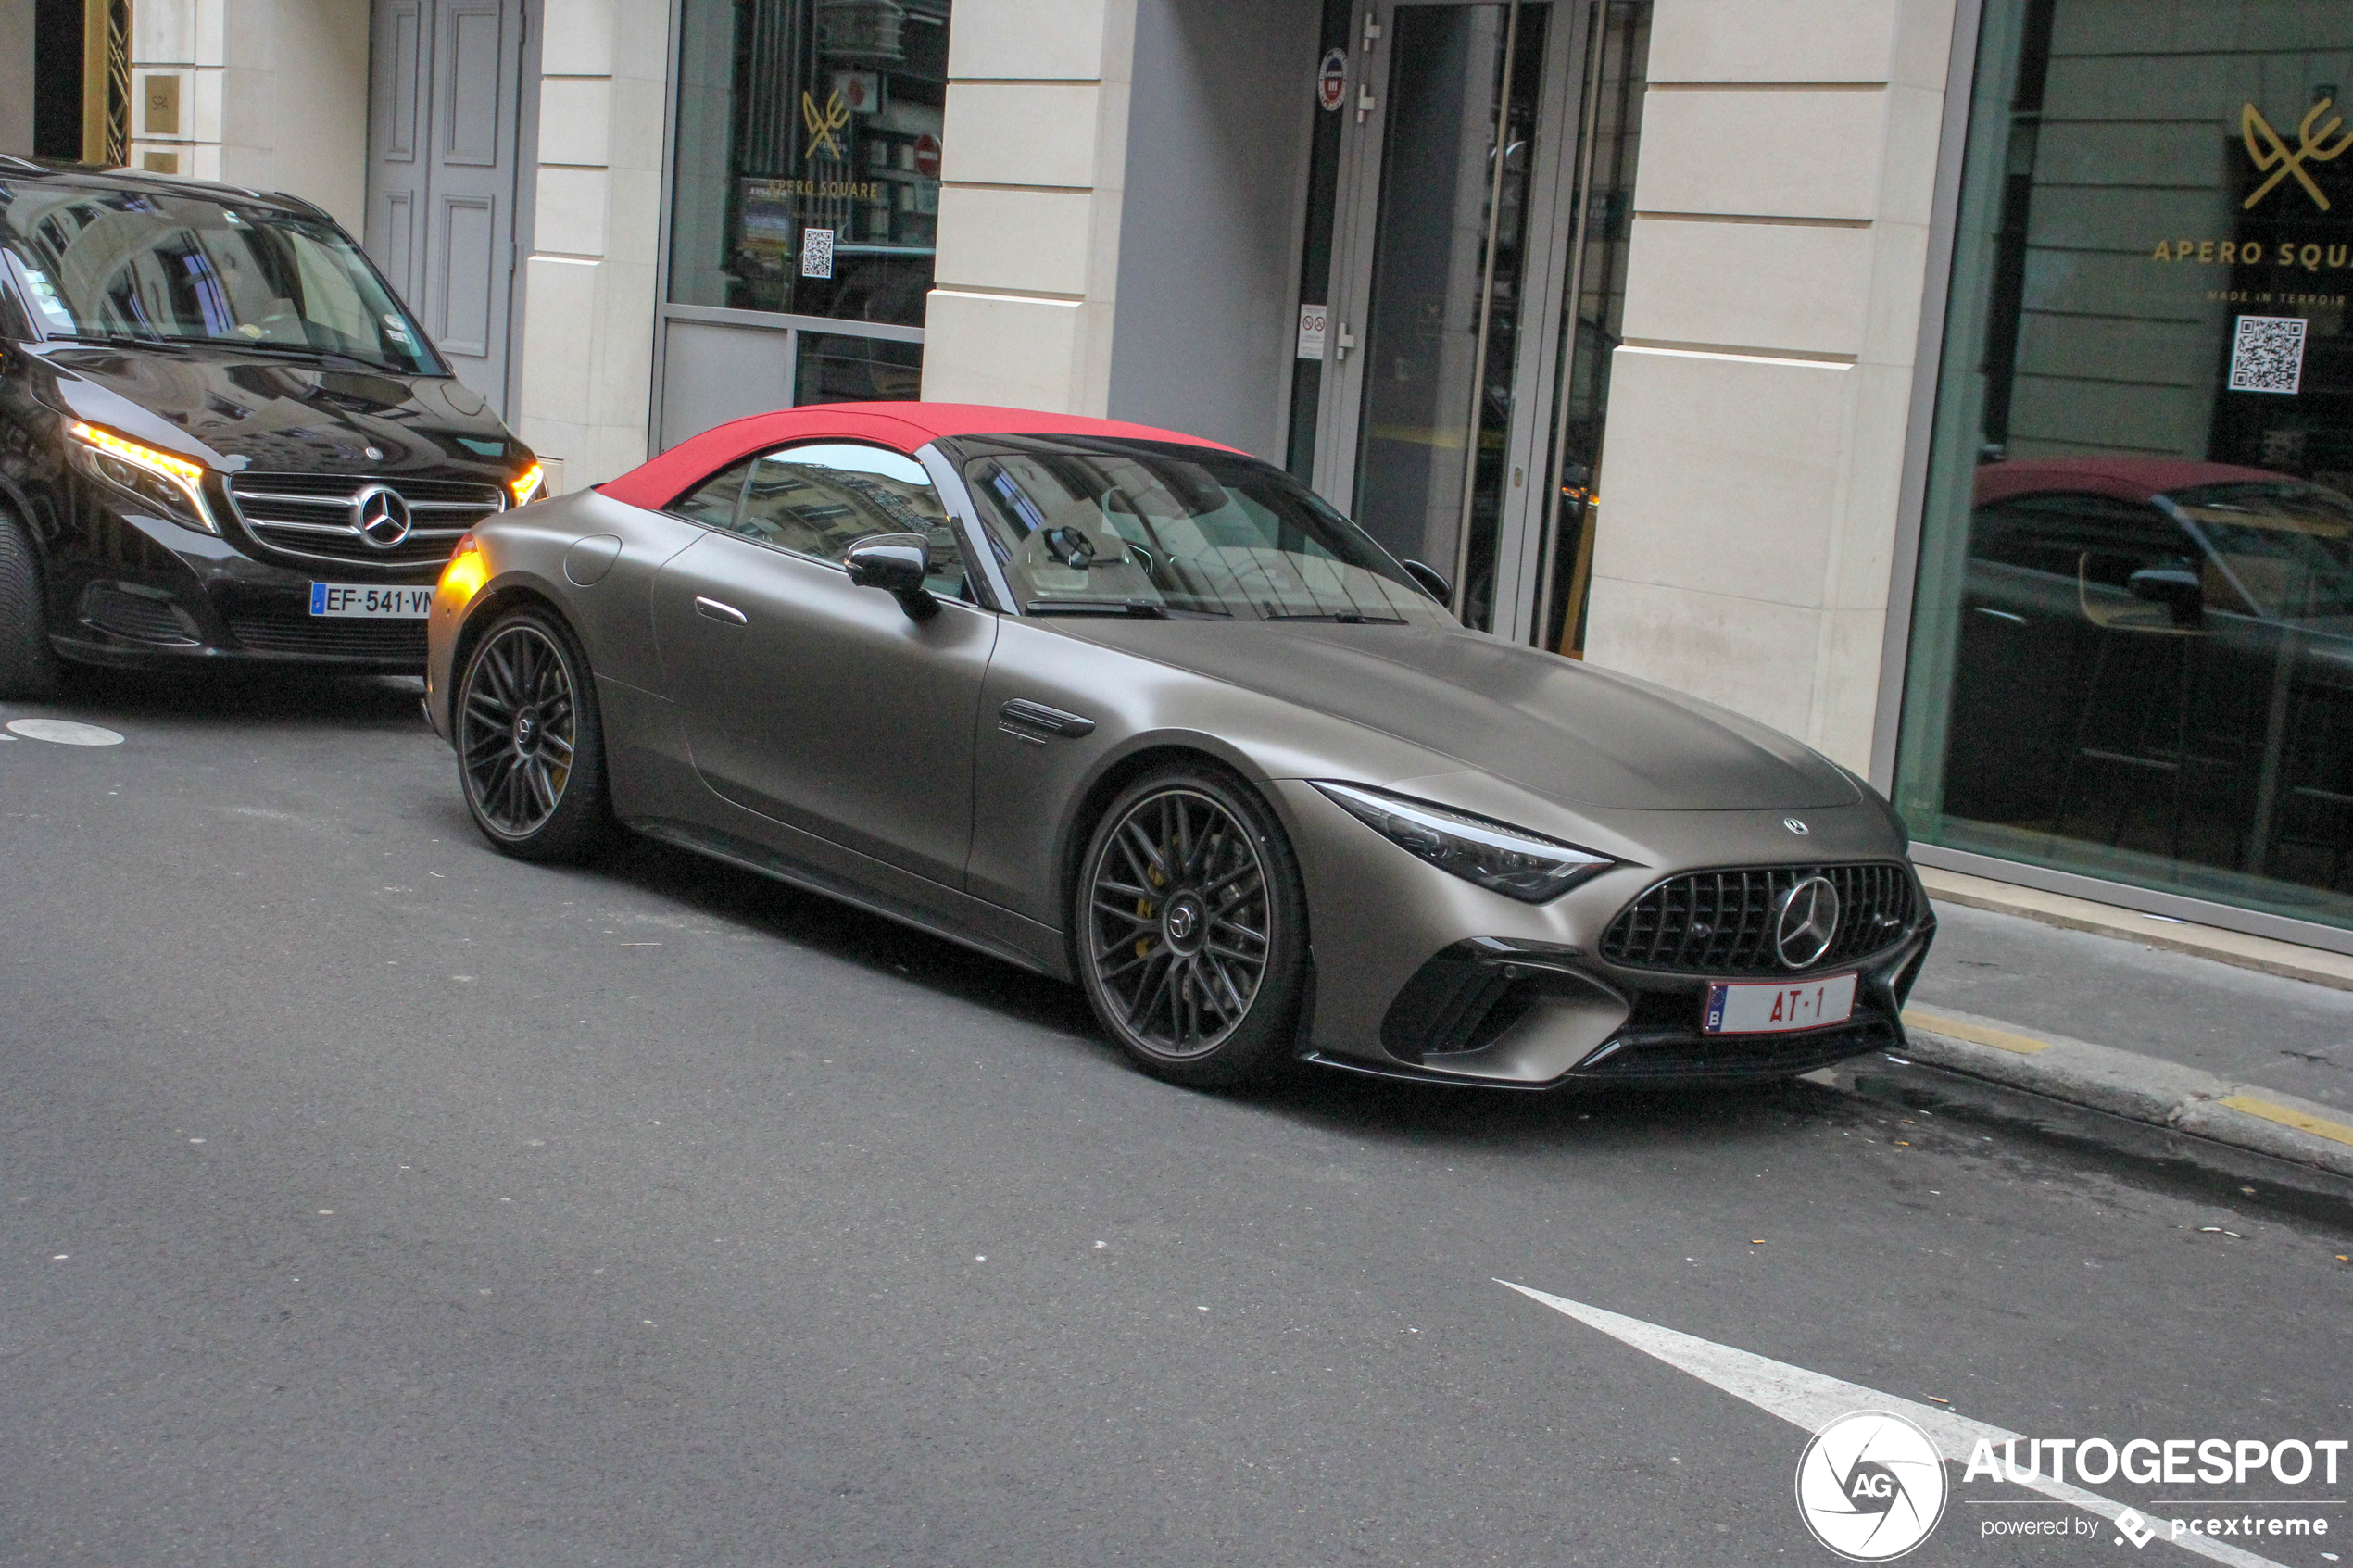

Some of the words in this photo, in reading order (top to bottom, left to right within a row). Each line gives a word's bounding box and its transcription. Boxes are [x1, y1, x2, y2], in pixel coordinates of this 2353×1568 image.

[152, 95, 169, 110] SPA
[769, 180, 814, 195] APERO
[820, 181, 878, 198] SQUARE
[2152, 239, 2262, 265] APERO
[2278, 243, 2353, 271] SQU
[2206, 291, 2249, 302] MADE
[2255, 292, 2271, 303] IN
[2280, 293, 2346, 307] TERROIR
[1769, 987, 1824, 1022] AT-1
[1709, 1011, 1720, 1026] B
